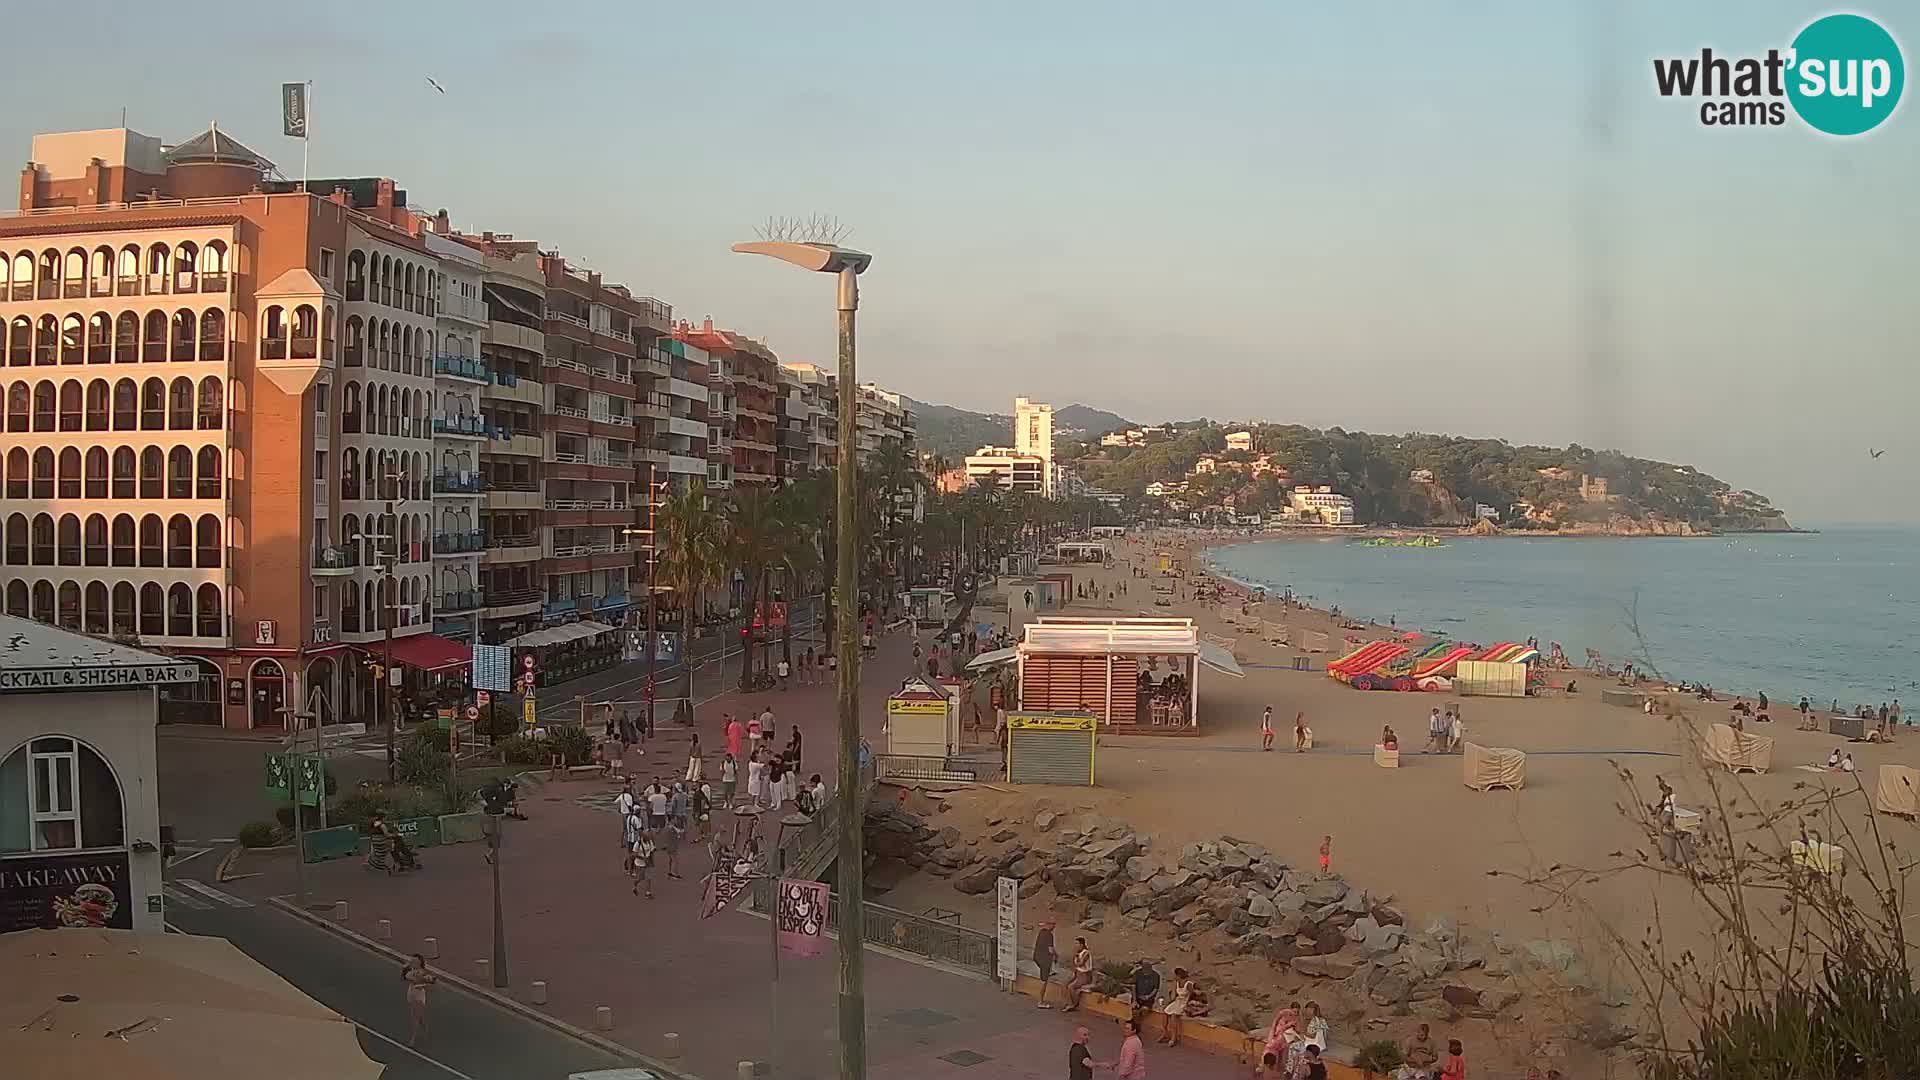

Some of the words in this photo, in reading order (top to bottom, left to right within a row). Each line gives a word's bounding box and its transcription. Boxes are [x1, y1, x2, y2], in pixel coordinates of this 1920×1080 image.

[314, 627, 331, 643] KFC
[63, 671, 74, 684] &
[79, 669, 140, 685] SHISHA
[145, 668, 178, 682] BAR
[257, 665, 281, 676] KFC
